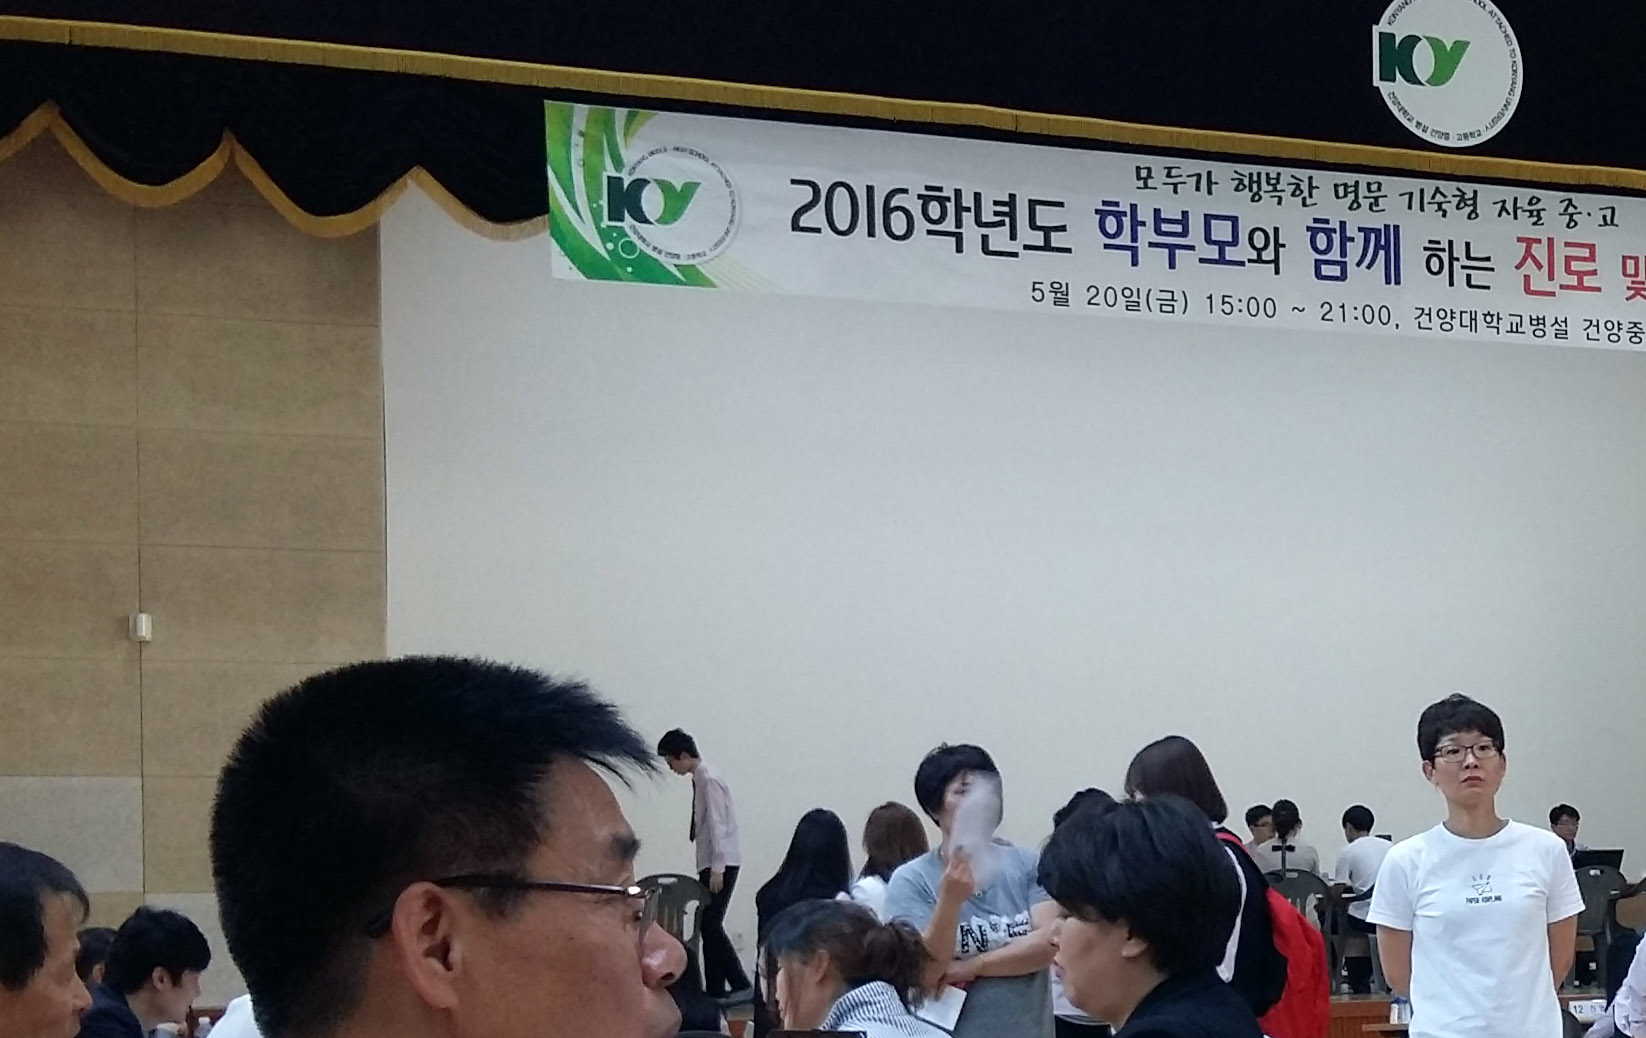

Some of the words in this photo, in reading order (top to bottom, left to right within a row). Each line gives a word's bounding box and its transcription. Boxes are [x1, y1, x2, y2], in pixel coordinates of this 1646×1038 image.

[1135, 165, 1219, 196] 모두가
[1231, 170, 1320, 207] 행복한
[1333, 179, 1388, 212] 명문
[1399, 186, 1480, 220] 기숙형
[1492, 195, 1546, 226] 자율
[790, 178, 1073, 259] 2016학년도
[1094, 200, 1287, 275] 학부모와
[1306, 217, 1401, 286] 함께
[1423, 239, 1495, 290] 하는
[1514, 236, 1602, 297] 진로
[1031, 281, 1070, 307] 5월
[1086, 285, 1189, 315] 20일(금)
[1206, 293, 1277, 318] 15:00
[1320, 301, 1400, 330] 21:00,
[1414, 306, 1570, 340] 건양대학교병설
[1573, 1004, 1584, 1014] 12
